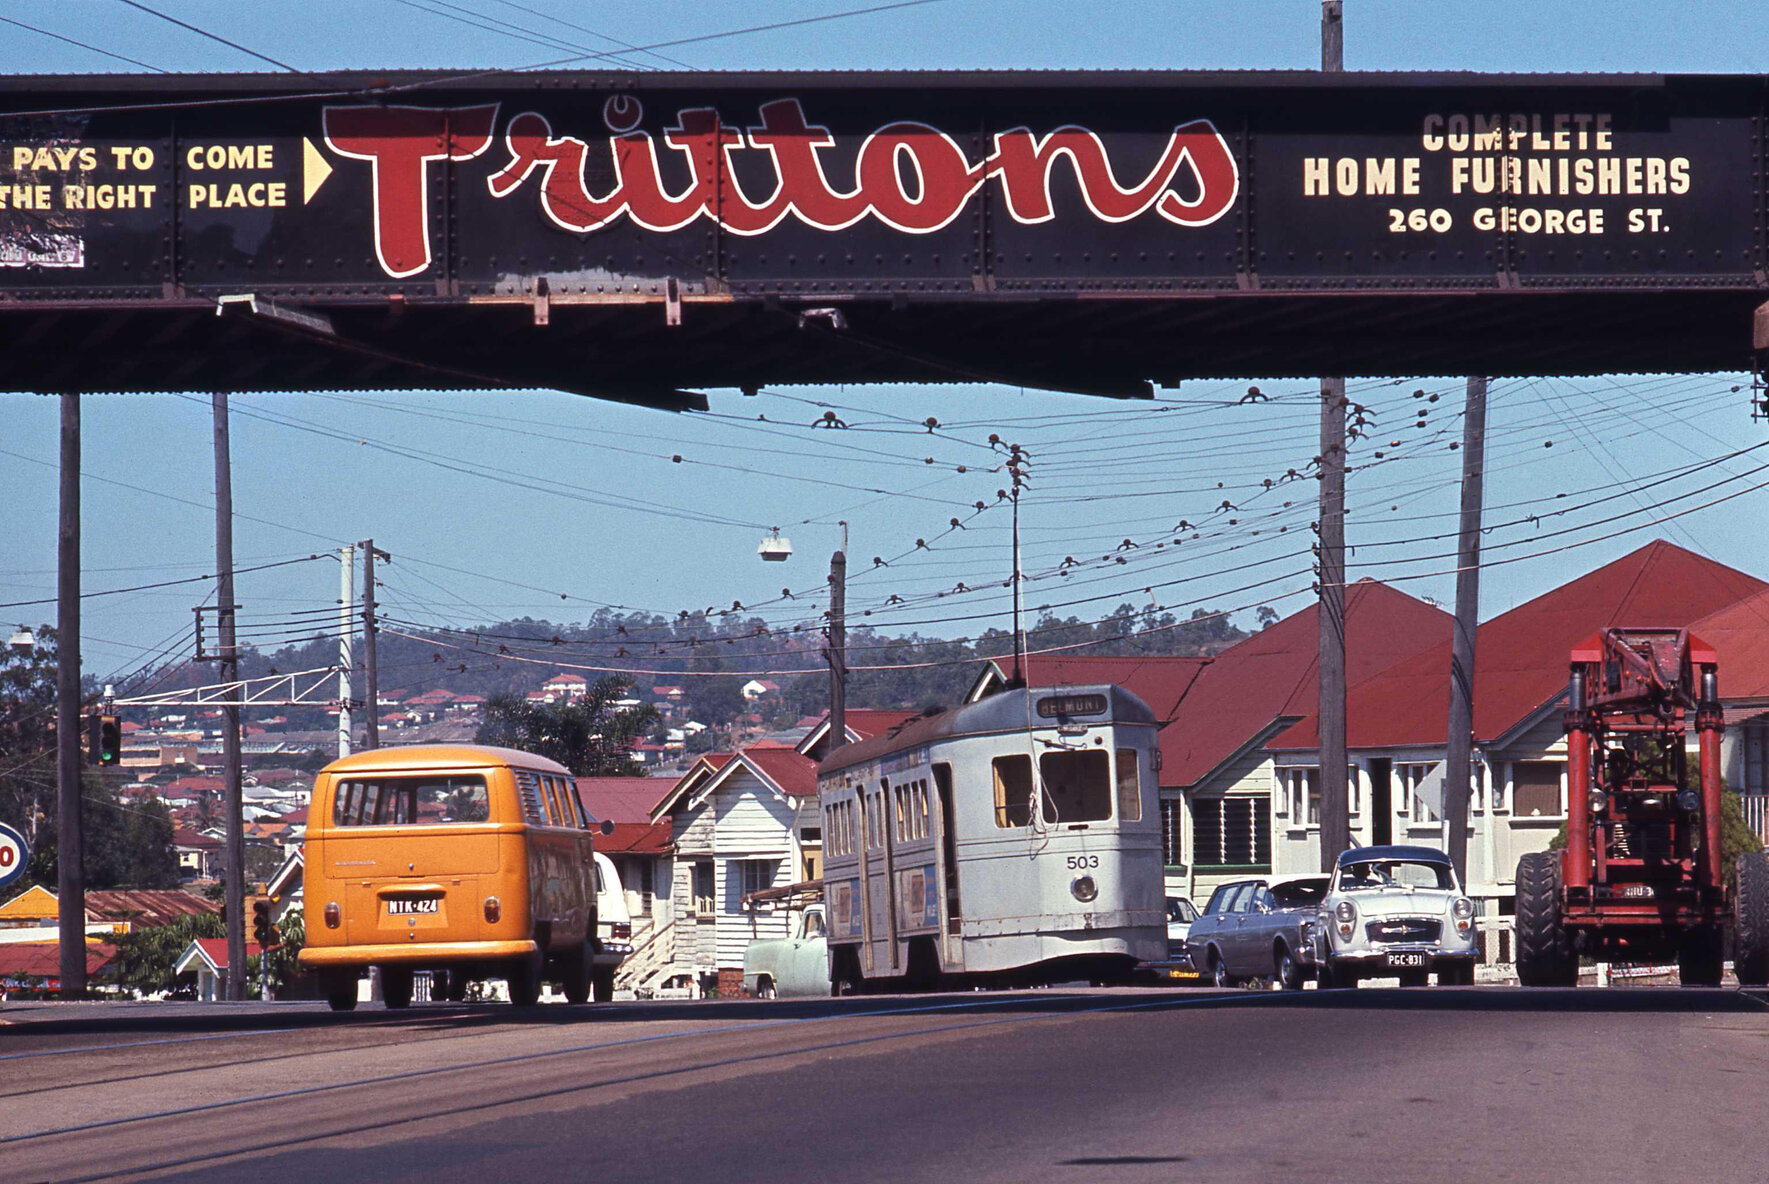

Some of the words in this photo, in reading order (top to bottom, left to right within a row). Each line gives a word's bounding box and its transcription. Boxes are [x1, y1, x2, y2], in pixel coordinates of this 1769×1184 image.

[1423, 113, 1612, 152] COMPLETE
[13, 146, 98, 171] PAYS
[111, 146, 154, 171] TO
[187, 145, 274, 170] COME
[322, 95, 1240, 278] Trittons
[1303, 157, 1421, 196] HOME
[1452, 156, 1691, 196] FURNISHERS
[0, 184, 51, 210] THE
[65, 184, 157, 210] RIGHT
[189, 182, 286, 209] PLACE
[1388, 207, 1453, 233] 260
[1473, 206, 1604, 234] GEORGE
[1627, 208, 1670, 233] ST.
[1041, 697, 1101, 714] BELMONT
[1067, 855, 1099, 870] 503
